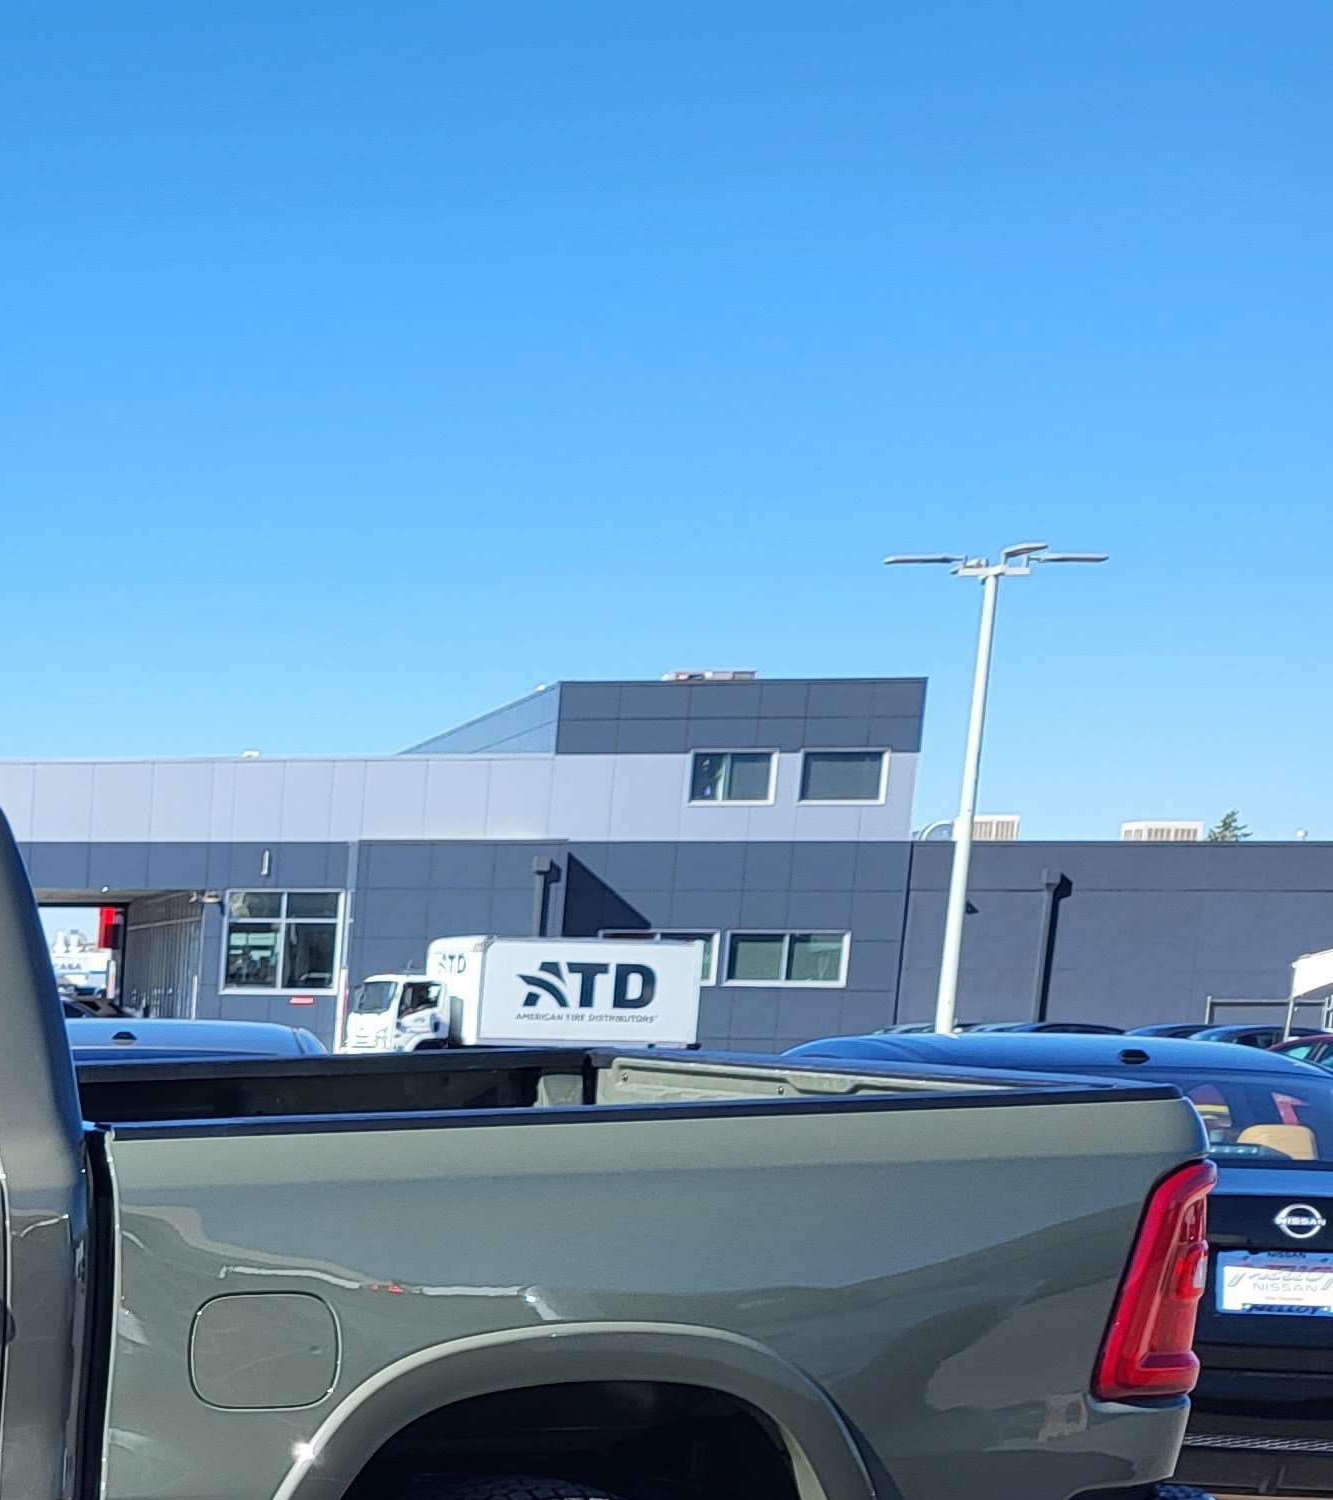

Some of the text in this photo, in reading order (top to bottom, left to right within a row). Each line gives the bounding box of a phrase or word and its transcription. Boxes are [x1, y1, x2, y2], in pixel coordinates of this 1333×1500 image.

[516, 961, 657, 1009] ATD
[1274, 1216, 1327, 1227] NISSAN
[1253, 1282, 1317, 1292] NISSAN
